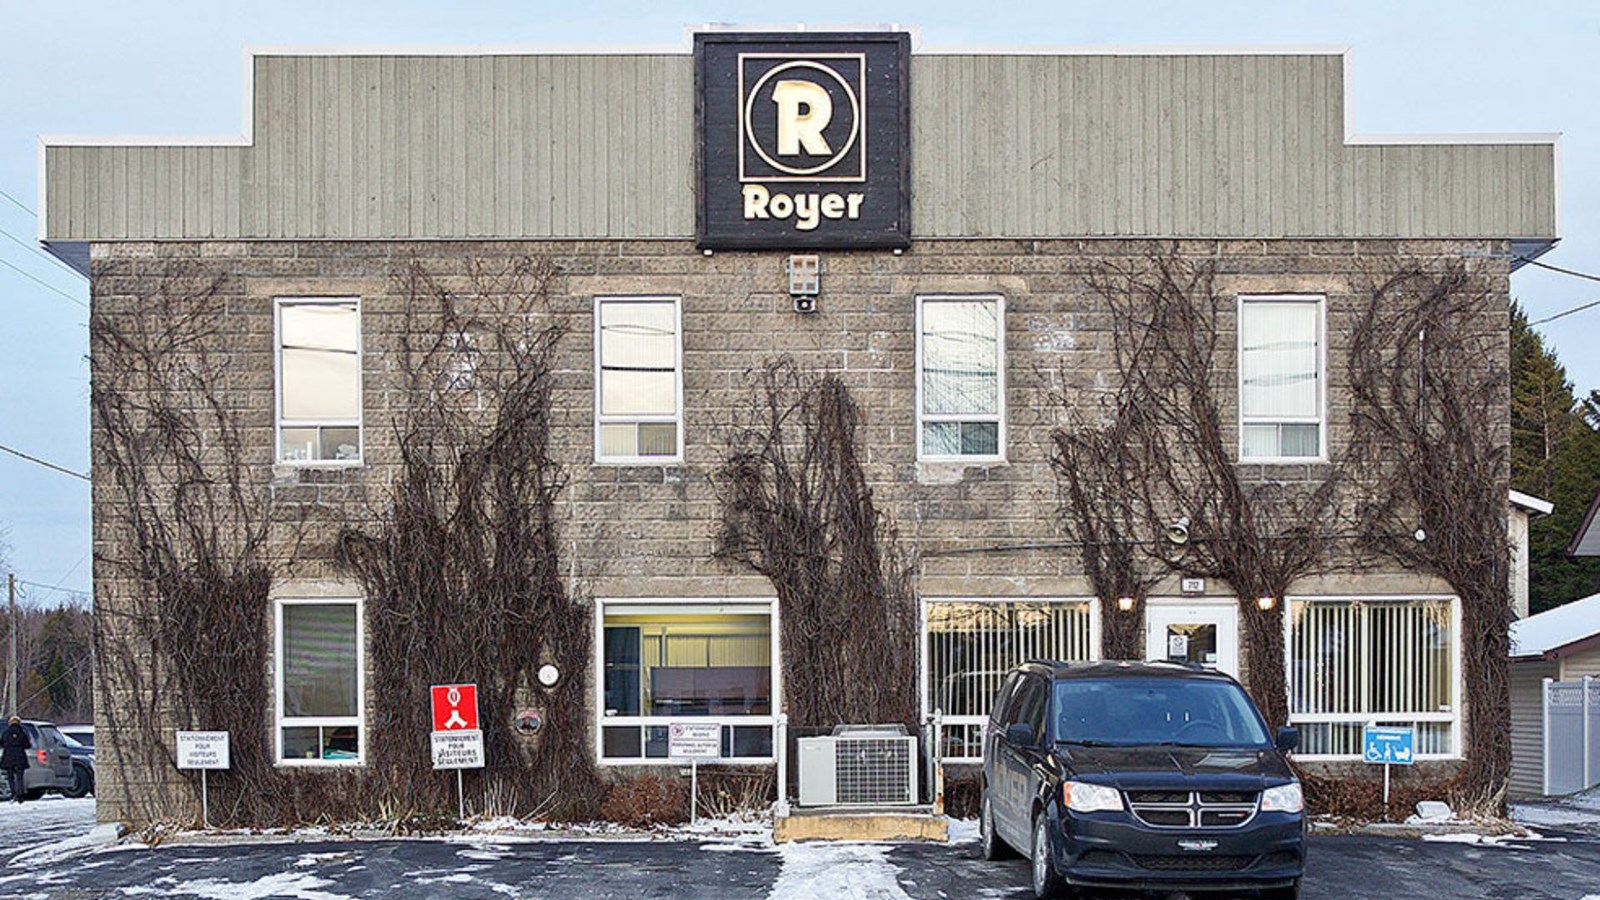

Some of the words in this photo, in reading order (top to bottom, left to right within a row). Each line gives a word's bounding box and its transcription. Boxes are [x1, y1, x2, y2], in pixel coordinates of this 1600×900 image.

[771, 79, 833, 155] R
[742, 184, 865, 230] Royer
[437, 757, 478, 765] SEULEMENT
[438, 749, 477, 757] VISITEURS
